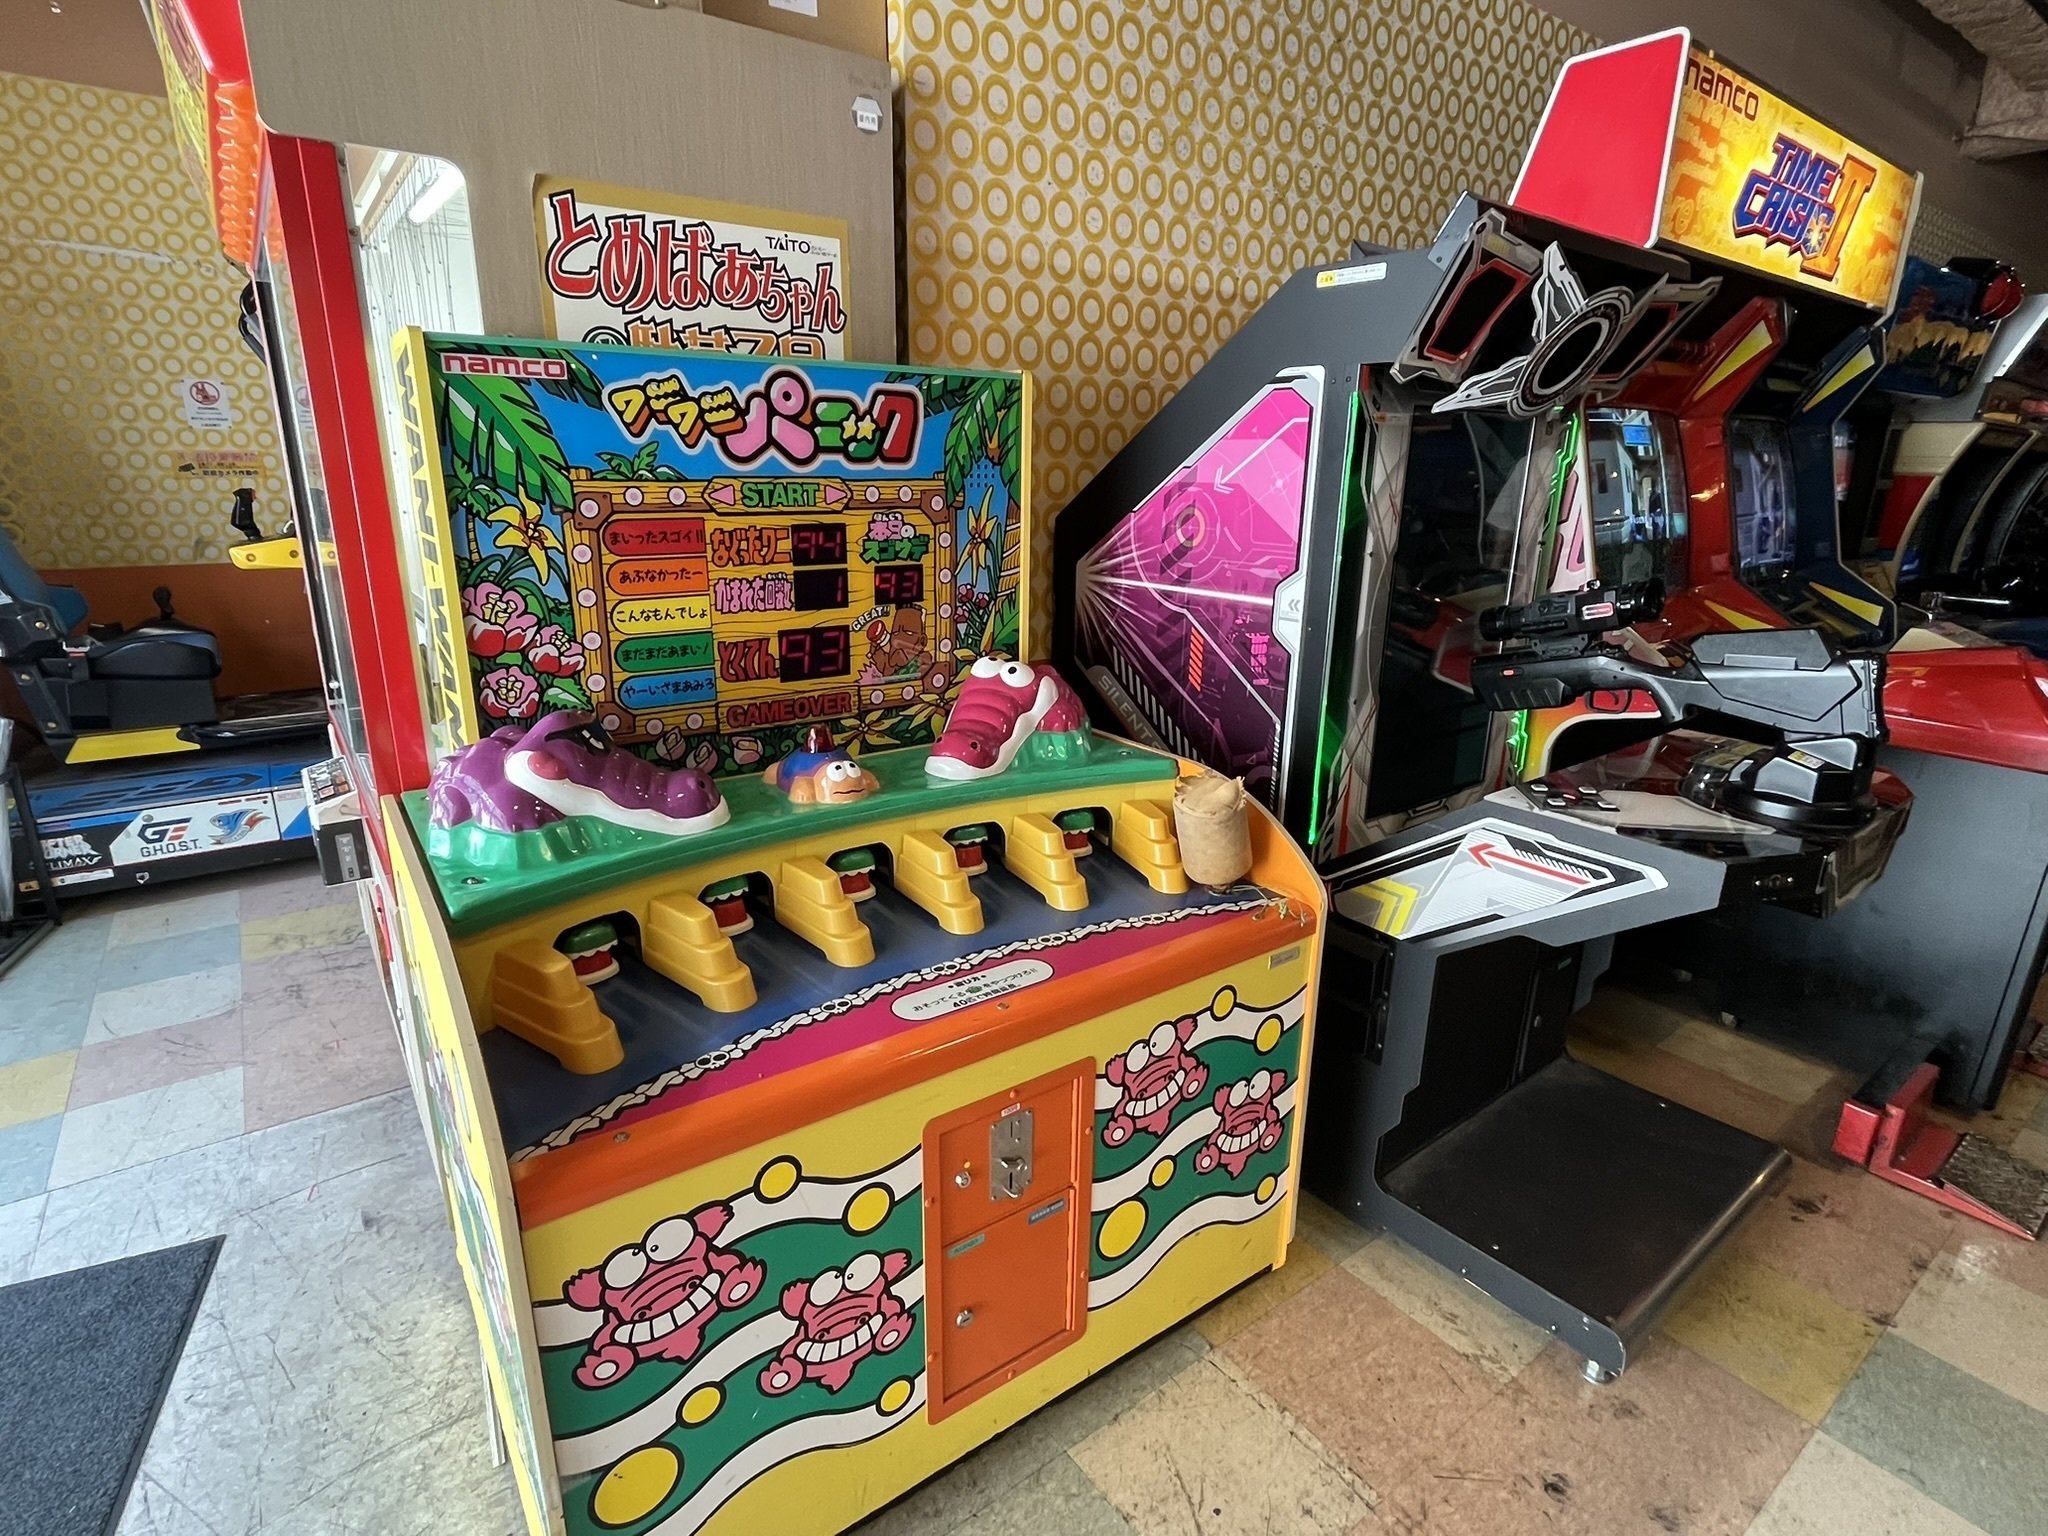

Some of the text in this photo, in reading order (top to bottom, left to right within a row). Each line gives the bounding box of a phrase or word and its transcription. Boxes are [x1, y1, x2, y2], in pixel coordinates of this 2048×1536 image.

[1684, 57, 1760, 122] namco
[1771, 132, 1842, 203] TIME
[1732, 168, 1836, 261] CRISIS
[545, 188, 847, 334] とめばあちゃん
[444, 354, 567, 378] namco
[598, 367, 921, 468] ワニワニパニック
[740, 481, 819, 507] START
[394, 345, 465, 750] WANI-WAN
[711, 525, 792, 567] なぐったワニ
[861, 535, 929, 563] スゴウデ
[616, 606, 708, 623] こんなもんでしょ
[718, 637, 780, 682] とくてん
[1098, 675, 1153, 739] SILENT
[46, 855, 103, 871] LIMAX
[140, 839, 202, 857] G.H.O.S.T.
